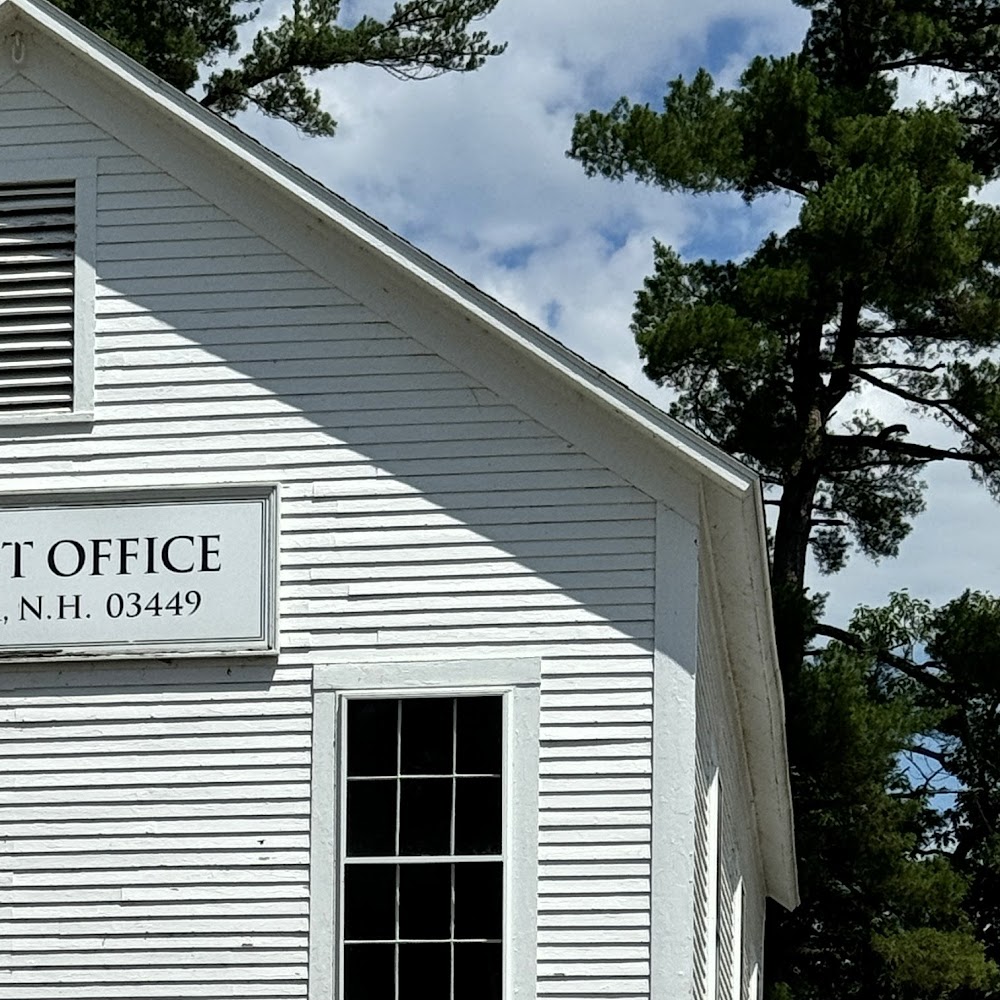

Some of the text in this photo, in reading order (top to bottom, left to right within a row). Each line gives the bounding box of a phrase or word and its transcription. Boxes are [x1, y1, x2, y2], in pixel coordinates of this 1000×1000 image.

[48, 534, 222, 577] OFFICE
[18, 594, 91, 621] N.H.
[106, 590, 202, 619] 03449
